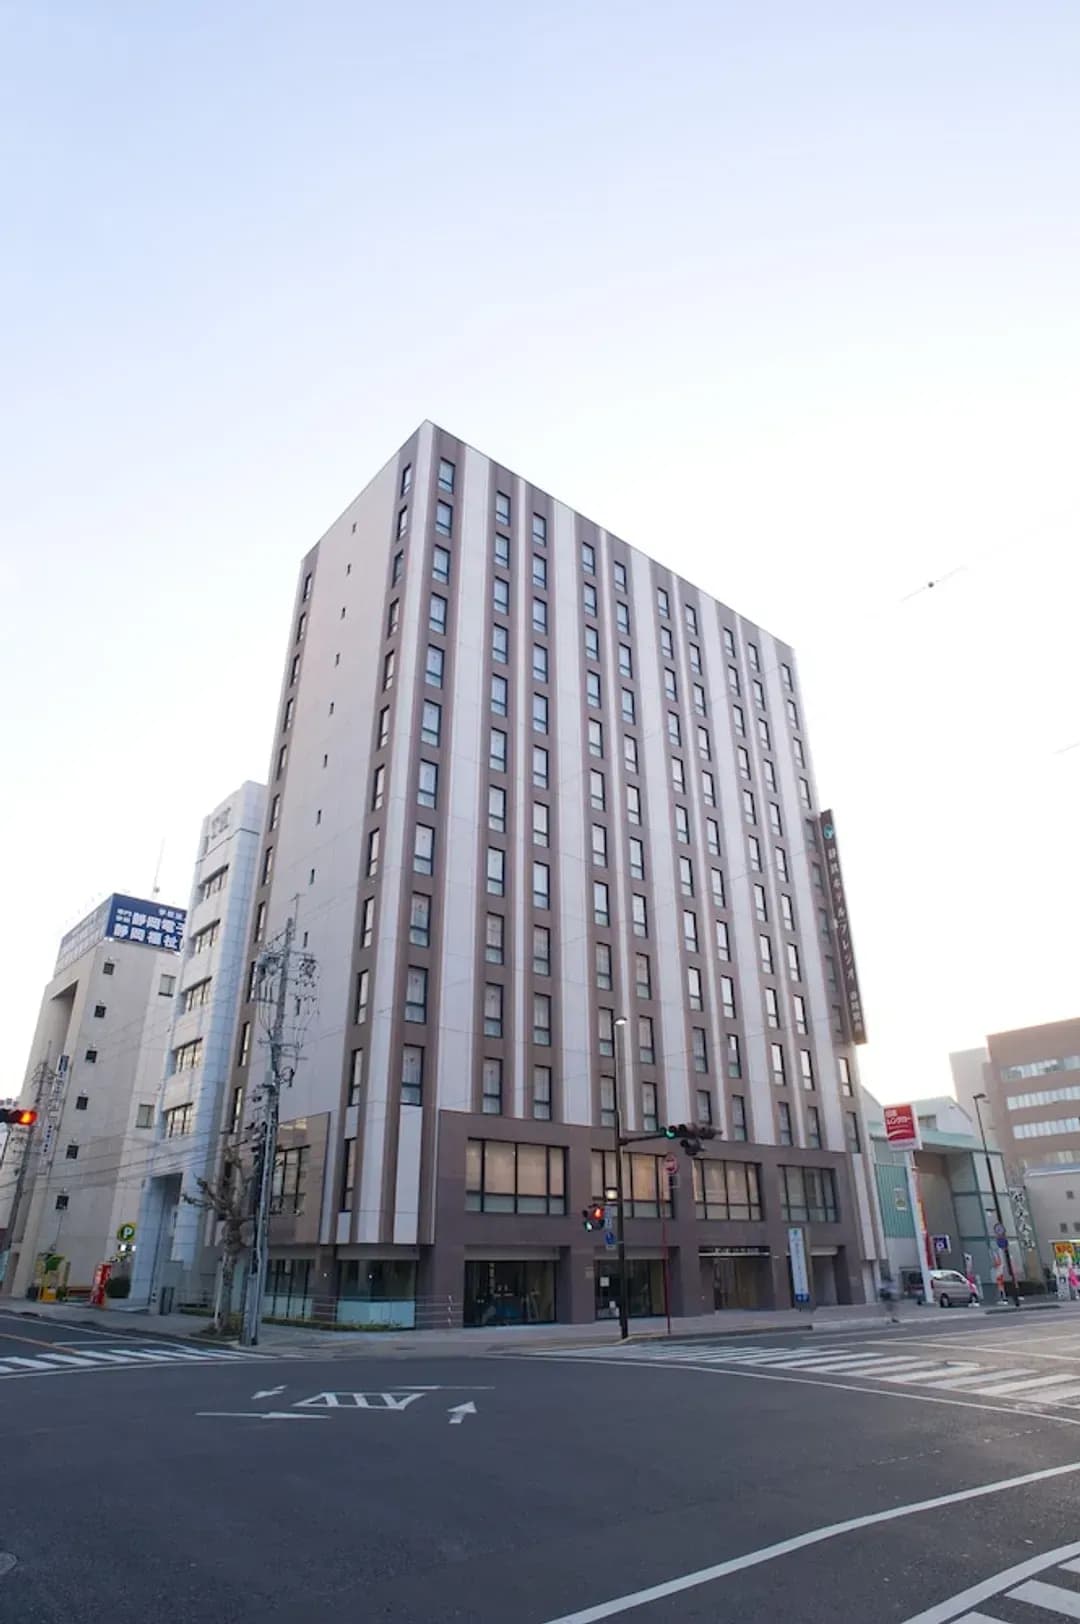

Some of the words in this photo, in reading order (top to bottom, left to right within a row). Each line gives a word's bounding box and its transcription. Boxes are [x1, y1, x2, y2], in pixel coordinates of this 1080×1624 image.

[113, 923, 184, 950] 静岡福祉
[123, 1226, 133, 1239] P
